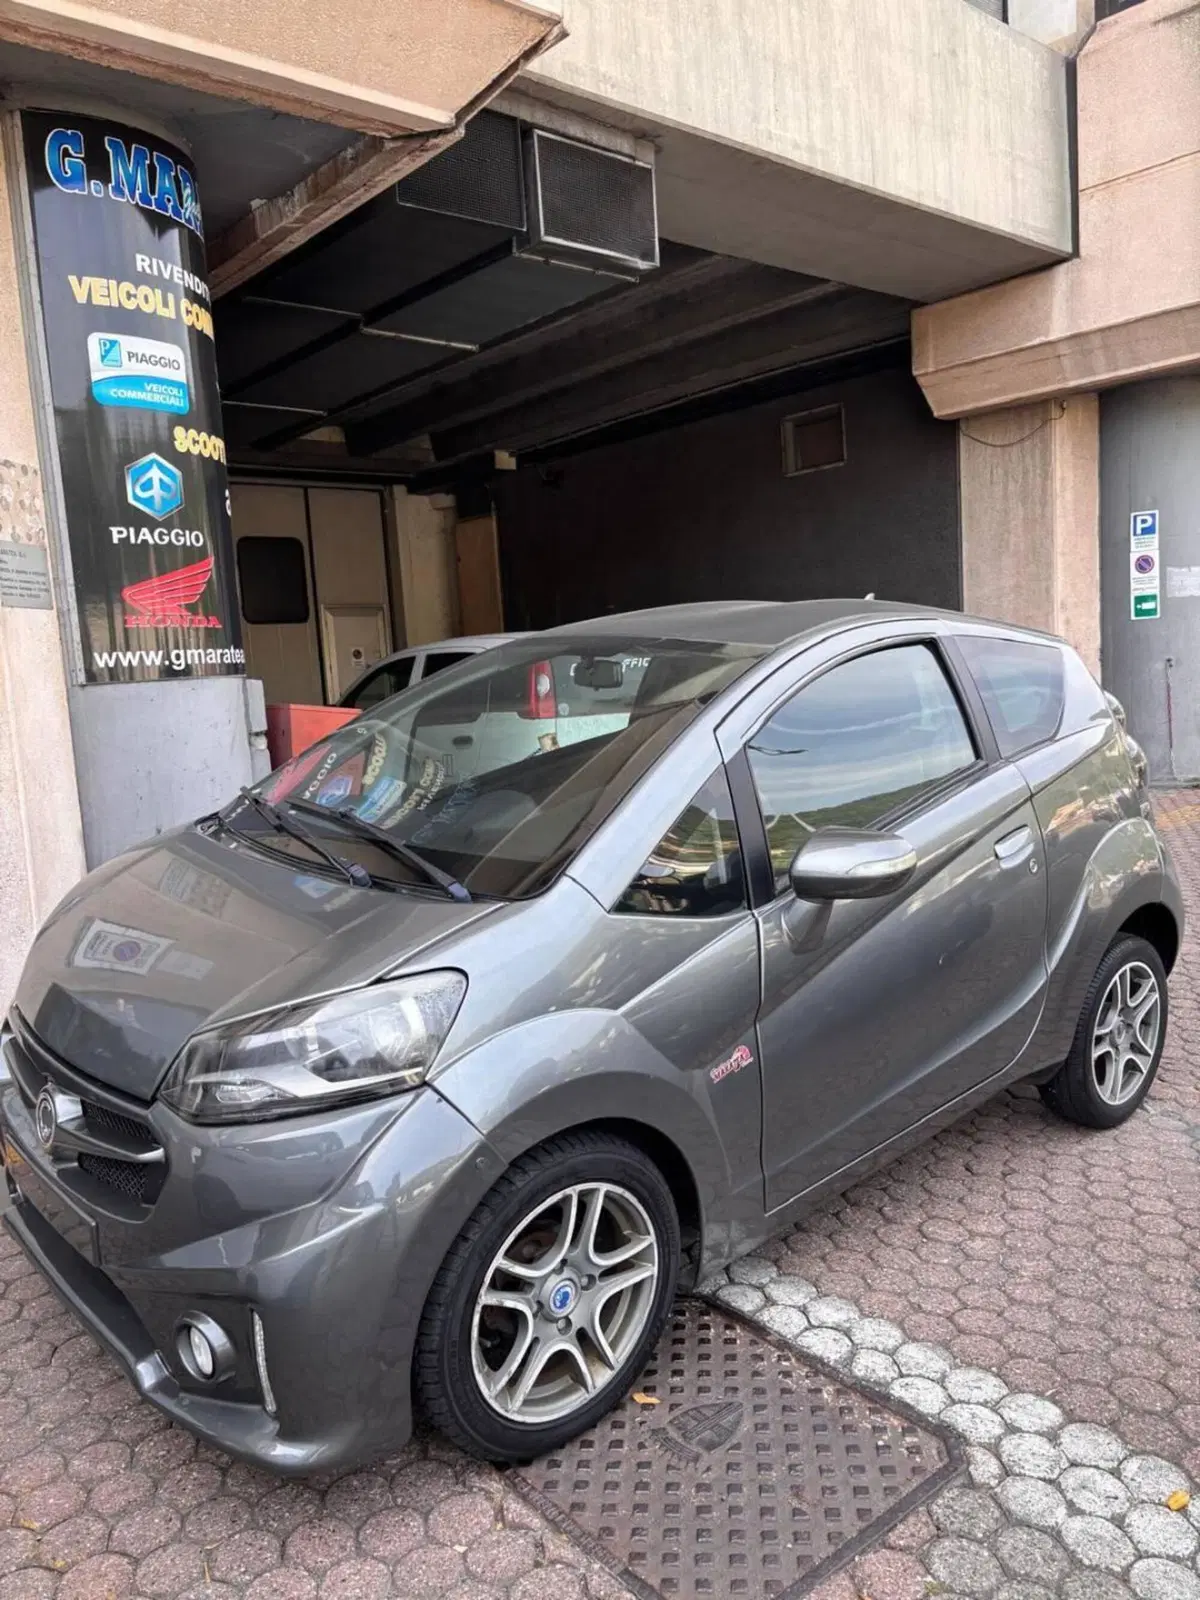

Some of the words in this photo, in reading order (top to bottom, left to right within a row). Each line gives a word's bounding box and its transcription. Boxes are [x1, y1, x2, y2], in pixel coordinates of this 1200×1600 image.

[68, 275, 176, 319] VEICOLI
[126, 351, 181, 371] PIAGGIO
[110, 388, 184, 407] COMMERCIALI
[144, 382, 183, 397] VEICOLI
[1136, 515, 1153, 534] P
[109, 526, 204, 547] PIAGGIO
[124, 615, 223, 628] HONDA
